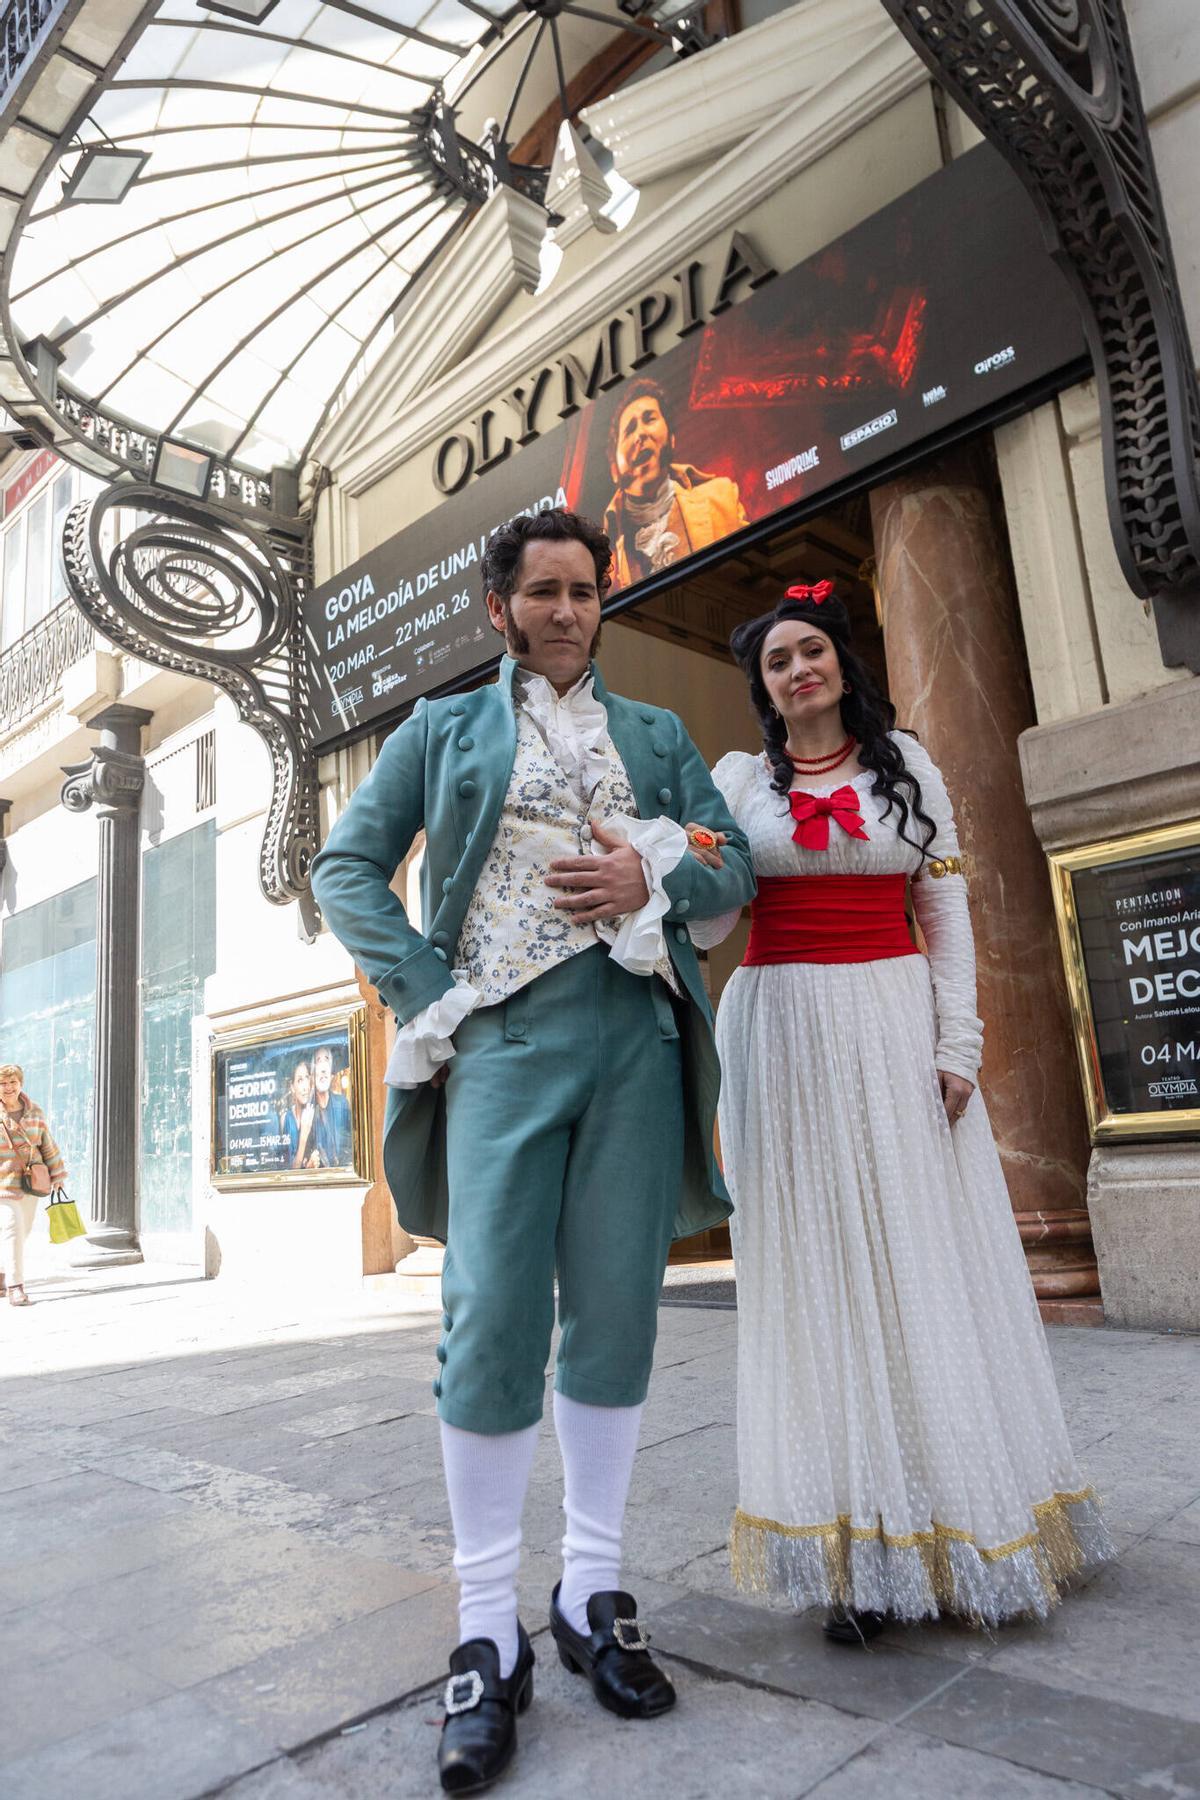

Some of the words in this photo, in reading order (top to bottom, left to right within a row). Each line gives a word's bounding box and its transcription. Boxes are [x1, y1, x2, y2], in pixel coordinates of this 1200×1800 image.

[432, 230, 779, 495] OLYMPIA
[843, 414, 893, 447] ESPACIO
[765, 445, 820, 491] SHOWPRIME
[325, 574, 375, 621] GOYA
[327, 630, 345, 651] LA
[347, 579, 414, 642] MELODÍA
[416, 564, 439, 597] DE
[440, 542, 478, 581] UNA
[330, 660, 346, 684] 20
[347, 644, 378, 675] MAR.
[395, 622, 413, 648] 22
[414, 602, 450, 637] MAR.
[452, 589, 471, 615] 26
[1116, 888, 1181, 910] PENTACION
[1120, 921, 1141, 932] Con
[1143, 912, 1180, 929] Imanol
[1129, 970, 1200, 1005] DEC
[1141, 1044, 1171, 1065] 04
[260, 1079, 276, 1095] NO
[1148, 1082, 1198, 1095] OLYMPIA
[229, 1101, 269, 1119] DECIRLO
